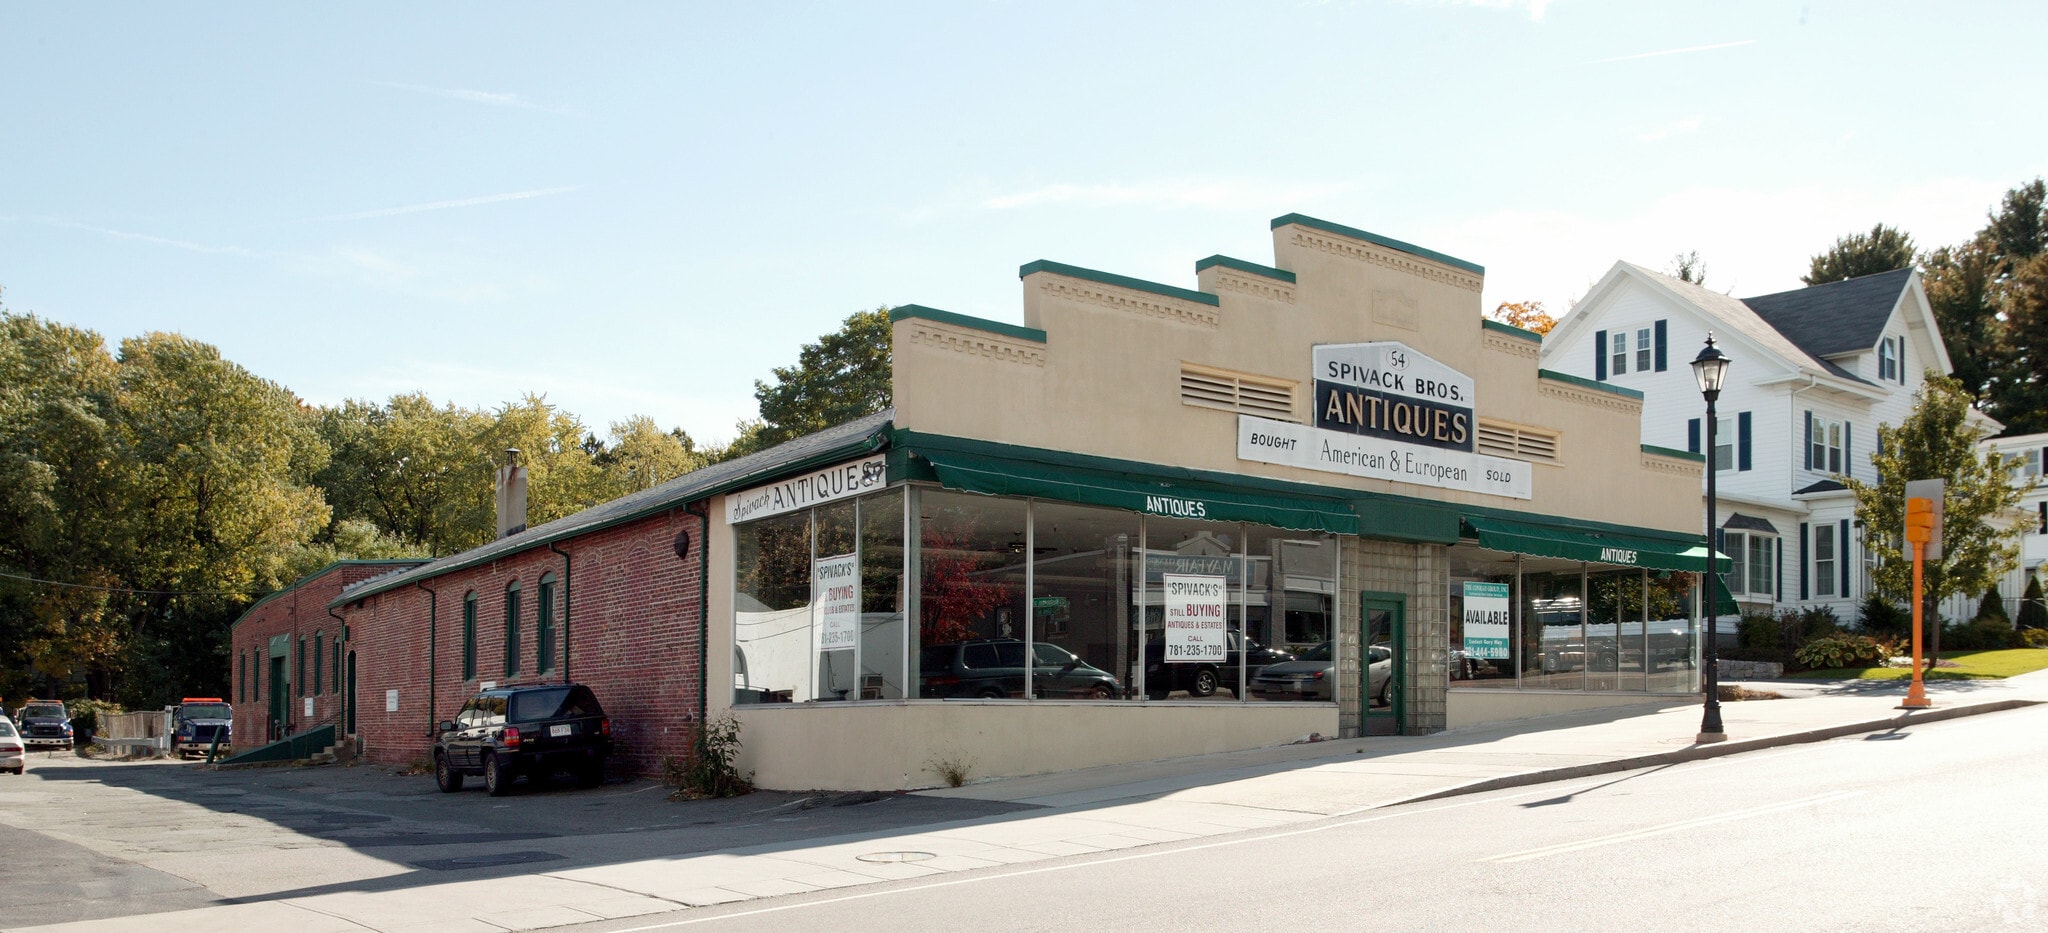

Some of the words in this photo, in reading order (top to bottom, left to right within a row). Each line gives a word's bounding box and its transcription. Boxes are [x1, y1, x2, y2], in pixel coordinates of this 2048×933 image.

[1391, 350, 1406, 368] 54
[1328, 361, 1405, 391] SPIVACK
[1415, 378, 1464, 402] BROS.
[1325, 389, 1467, 444] ANTIQUES
[1250, 433, 1297, 451] BOUGHT
[1320, 438, 1385, 470] American
[1389, 450, 1401, 473] &
[1405, 452, 1467, 482] European
[1486, 469, 1512, 483] SOLD
[1146, 495, 1206, 517] ANTIQUES
[1600, 547, 1637, 564] ANTIQUES
[828, 585, 853, 602] BUYING
[1168, 582, 1222, 597] "SPIVACK'S"
[1169, 608, 1185, 617] STILL
[1186, 604, 1221, 617] BUYING
[1465, 610, 1508, 625] AVAILABLE
[830, 620, 840, 628] CALL
[1167, 621, 1194, 629] ANTIQUES
[1201, 621, 1222, 629] ESTATES
[1169, 644, 1222, 656] 781-235-1700
